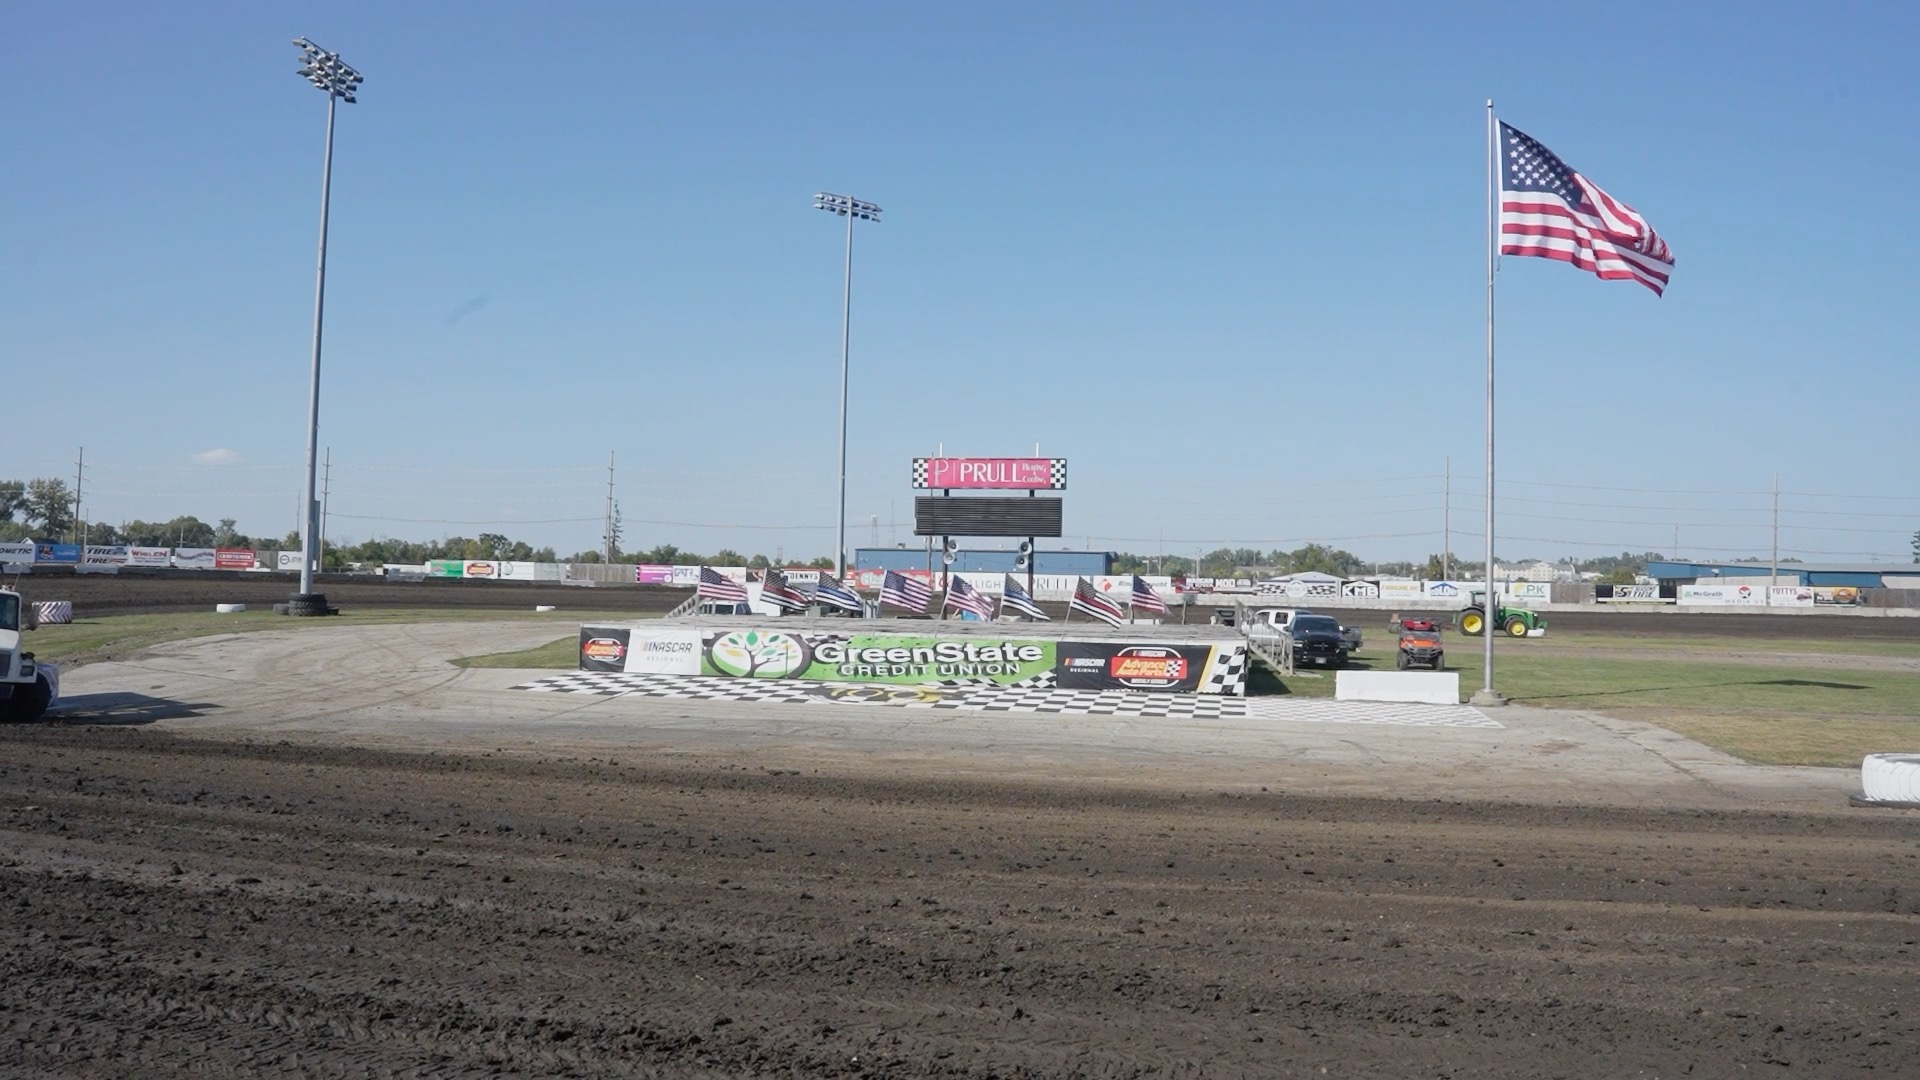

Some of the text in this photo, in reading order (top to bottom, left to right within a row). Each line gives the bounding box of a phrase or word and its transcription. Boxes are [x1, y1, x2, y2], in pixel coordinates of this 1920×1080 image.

[960, 463, 1023, 483] PRULL
[1343, 586, 1378, 597] KMB
[652, 642, 693, 653] NASCAR
[813, 642, 1044, 664] GreenState
[840, 663, 1021, 677] CREDIT UNION
[1122, 659, 1167, 669] Advance
